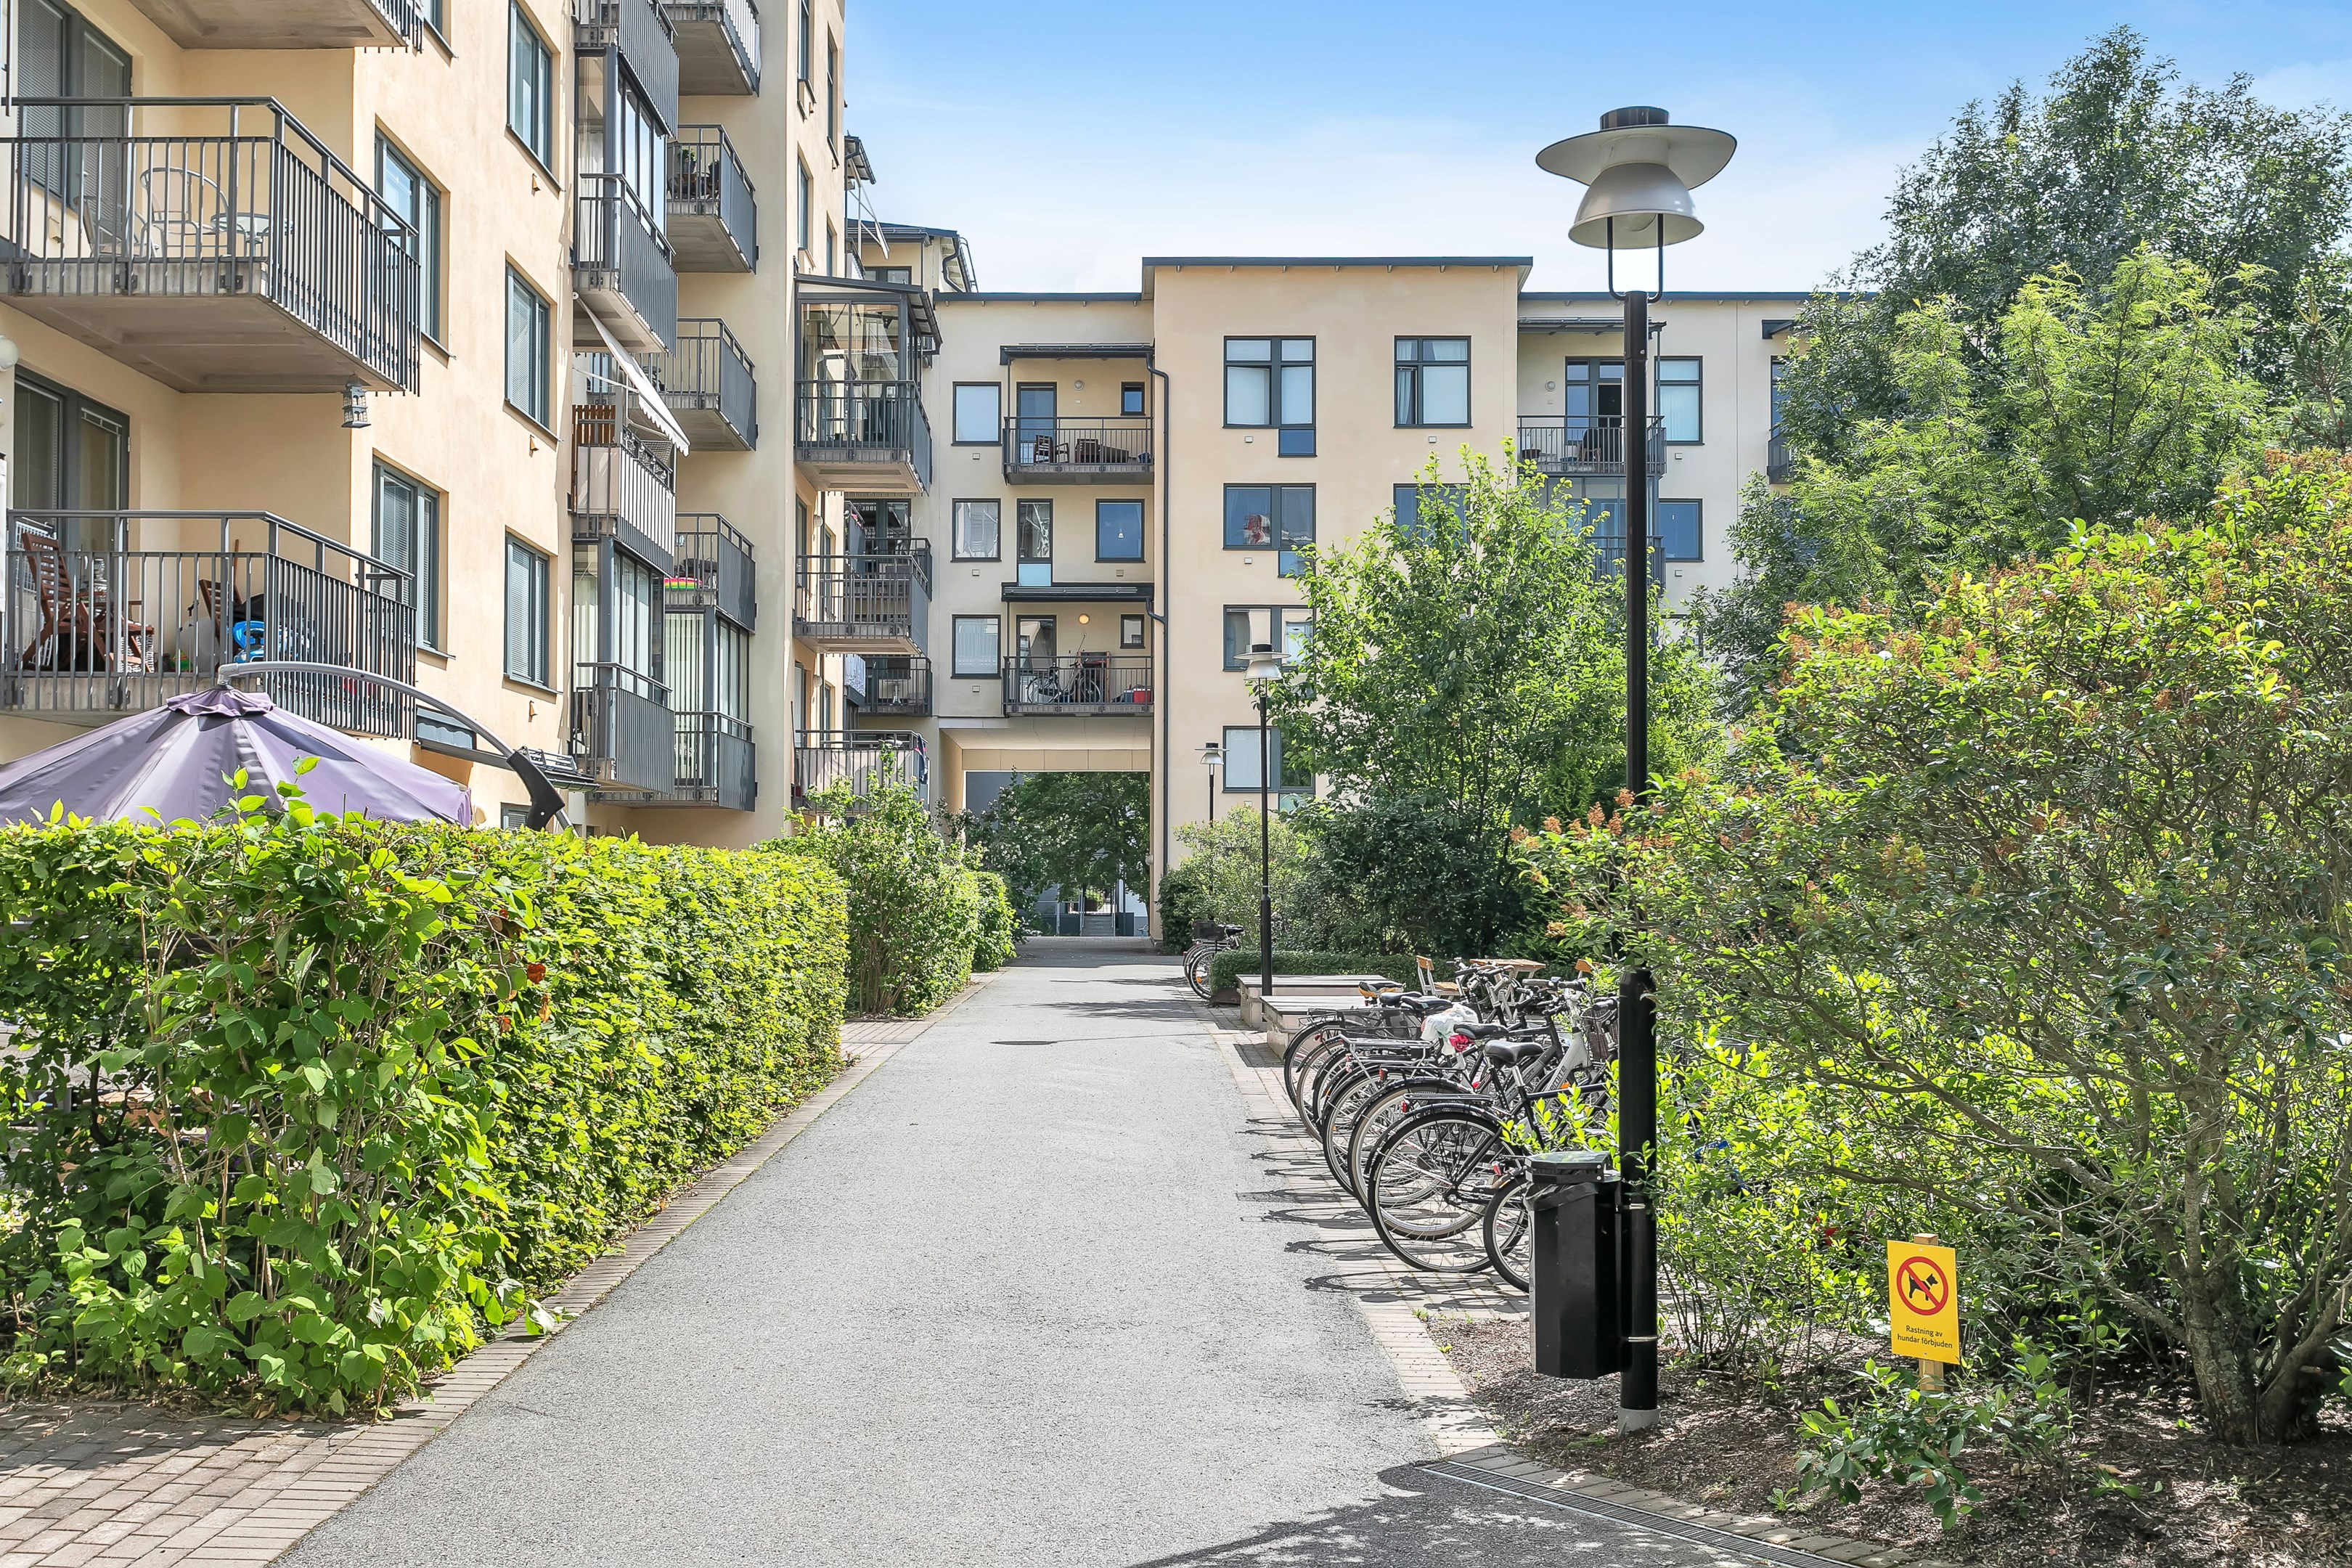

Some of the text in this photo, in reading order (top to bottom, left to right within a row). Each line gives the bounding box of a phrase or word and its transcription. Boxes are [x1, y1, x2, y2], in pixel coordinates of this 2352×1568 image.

[1906, 1325, 1934, 1337] Rastning
[1897, 1334, 1953, 1348] hundar förbjuden
